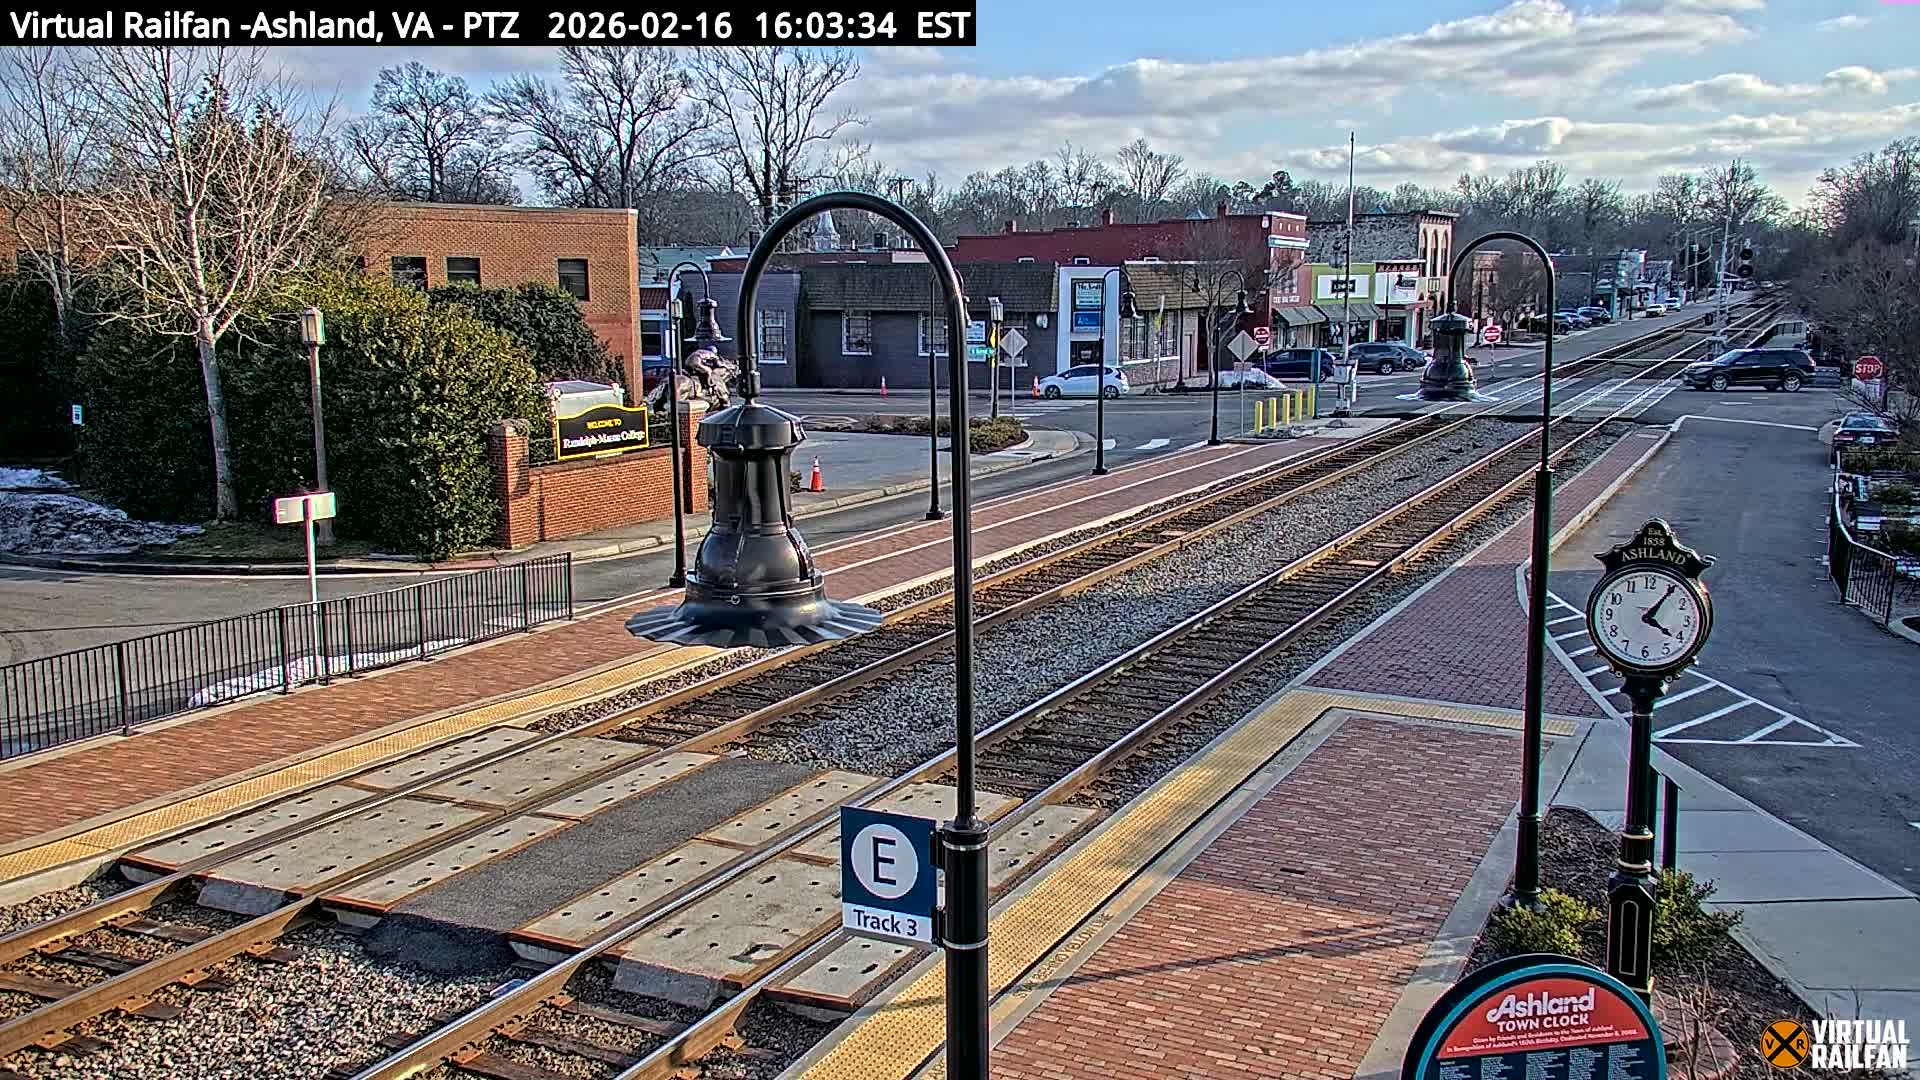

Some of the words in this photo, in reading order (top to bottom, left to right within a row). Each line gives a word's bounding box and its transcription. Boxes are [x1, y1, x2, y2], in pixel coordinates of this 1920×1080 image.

[1856, 364, 1880, 374] STOP
[1644, 537, 1665, 546] 1858
[1621, 548, 1686, 565] ASHLAND
[1626, 581, 1636, 593] 11
[1644, 577, 1656, 590] 12
[1611, 593, 1622, 605] 10
[1679, 598, 1686, 610] 2
[1606, 609, 1613, 620] 9
[1683, 616, 1690, 627] 3
[1609, 625, 1618, 637] 8
[1676, 631, 1684, 643] 4
[1621, 640, 1630, 651] 7
[1662, 643, 1670, 655] 5
[1642, 646, 1649, 658] 6
[872, 836, 896, 886] E
[853, 909, 900, 934] Track
[906, 919, 917, 936] 3
[1486, 987, 1595, 1022] Ashland
[1497, 1018, 1539, 1032] TOWN
[1542, 1014, 1588, 1028] CLOCK
